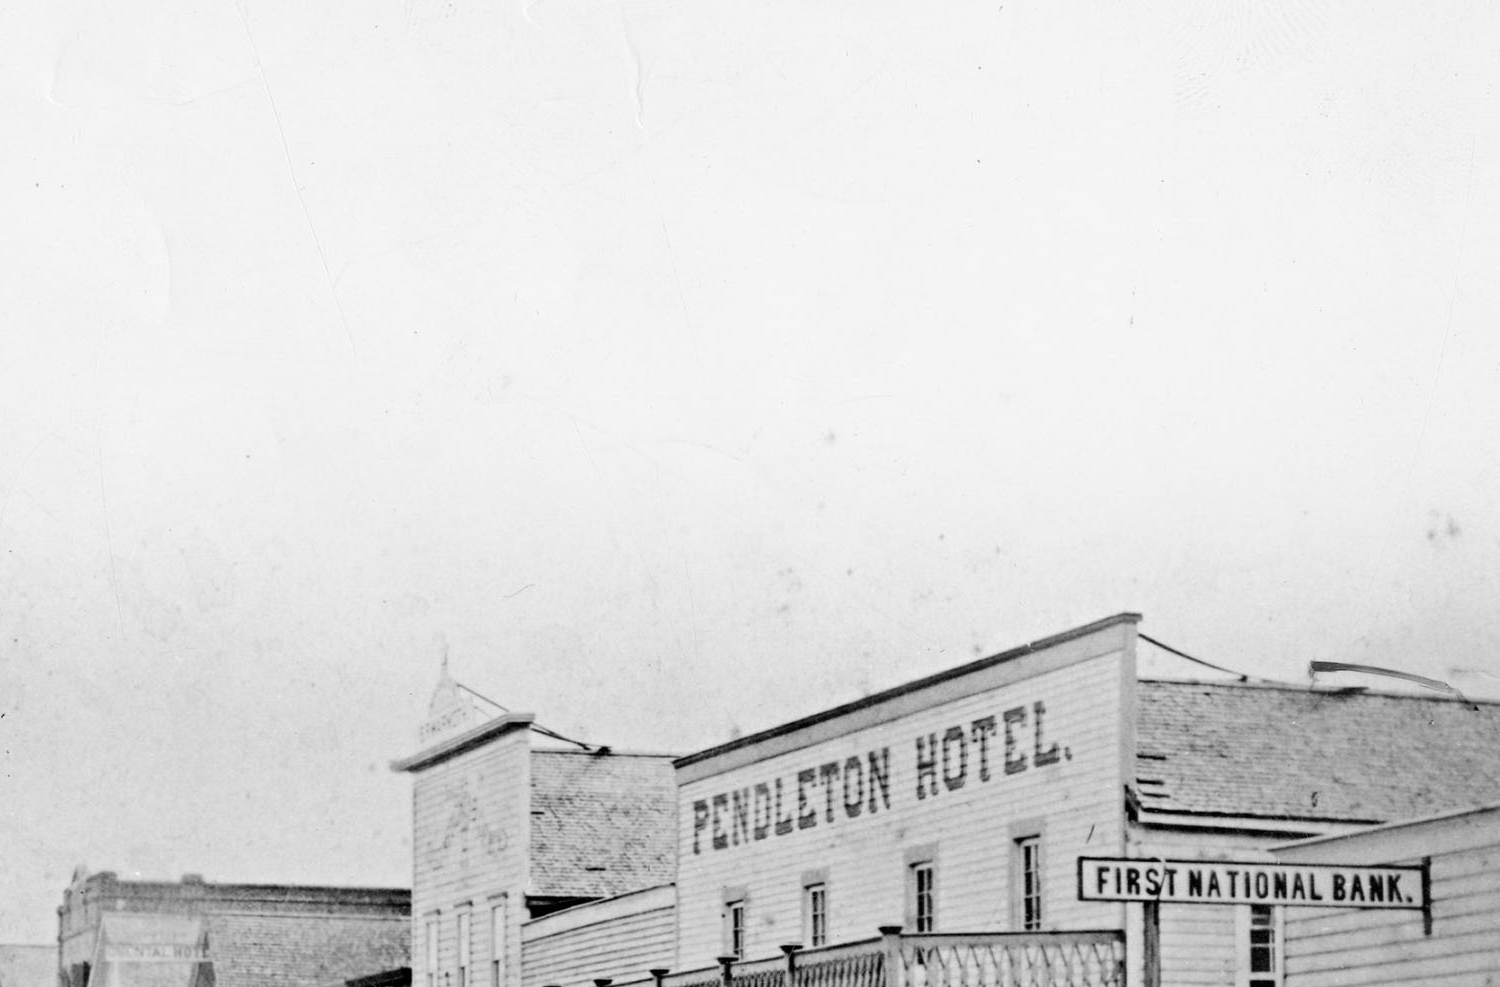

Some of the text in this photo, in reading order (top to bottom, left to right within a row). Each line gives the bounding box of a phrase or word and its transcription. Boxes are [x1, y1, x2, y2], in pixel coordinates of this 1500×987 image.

[692, 700, 1073, 856] PENDLETON HOTEL.
[1096, 866, 1414, 904] FIRST NATIONAL BANK.
